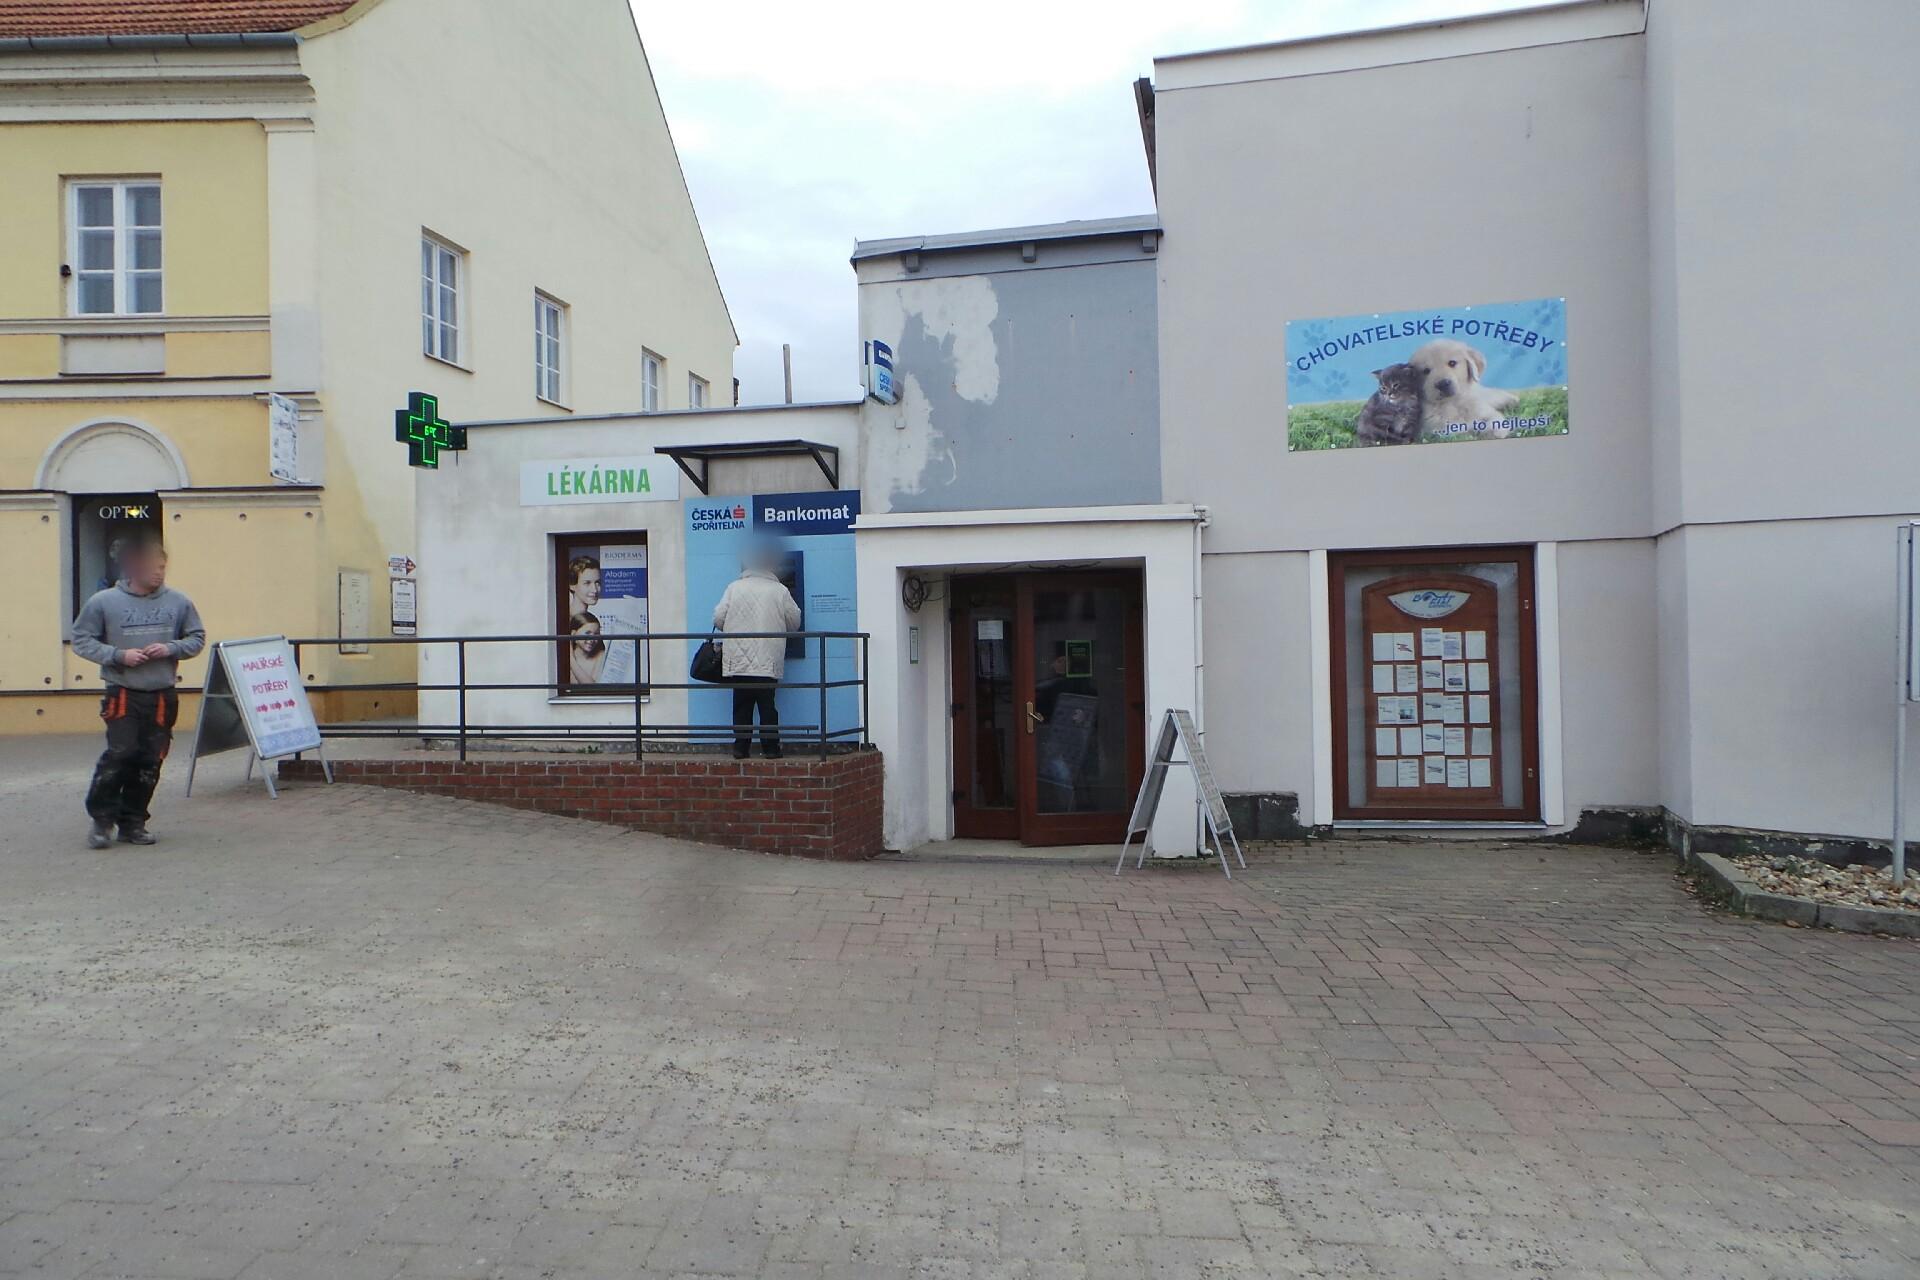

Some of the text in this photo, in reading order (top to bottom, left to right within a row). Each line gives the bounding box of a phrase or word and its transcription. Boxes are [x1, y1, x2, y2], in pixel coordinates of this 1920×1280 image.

[1297, 315, 1555, 371] CHOVATELSKÉ POTŘEBY
[1473, 420, 1487, 431] to
[547, 463, 651, 496] LÉKÁRNA
[691, 505, 732, 521] ČESKÁ
[764, 504, 850, 523] Bankomat
[691, 520, 745, 531] SPOŘITELNA
[251, 679, 289, 695] POTŘEBY
